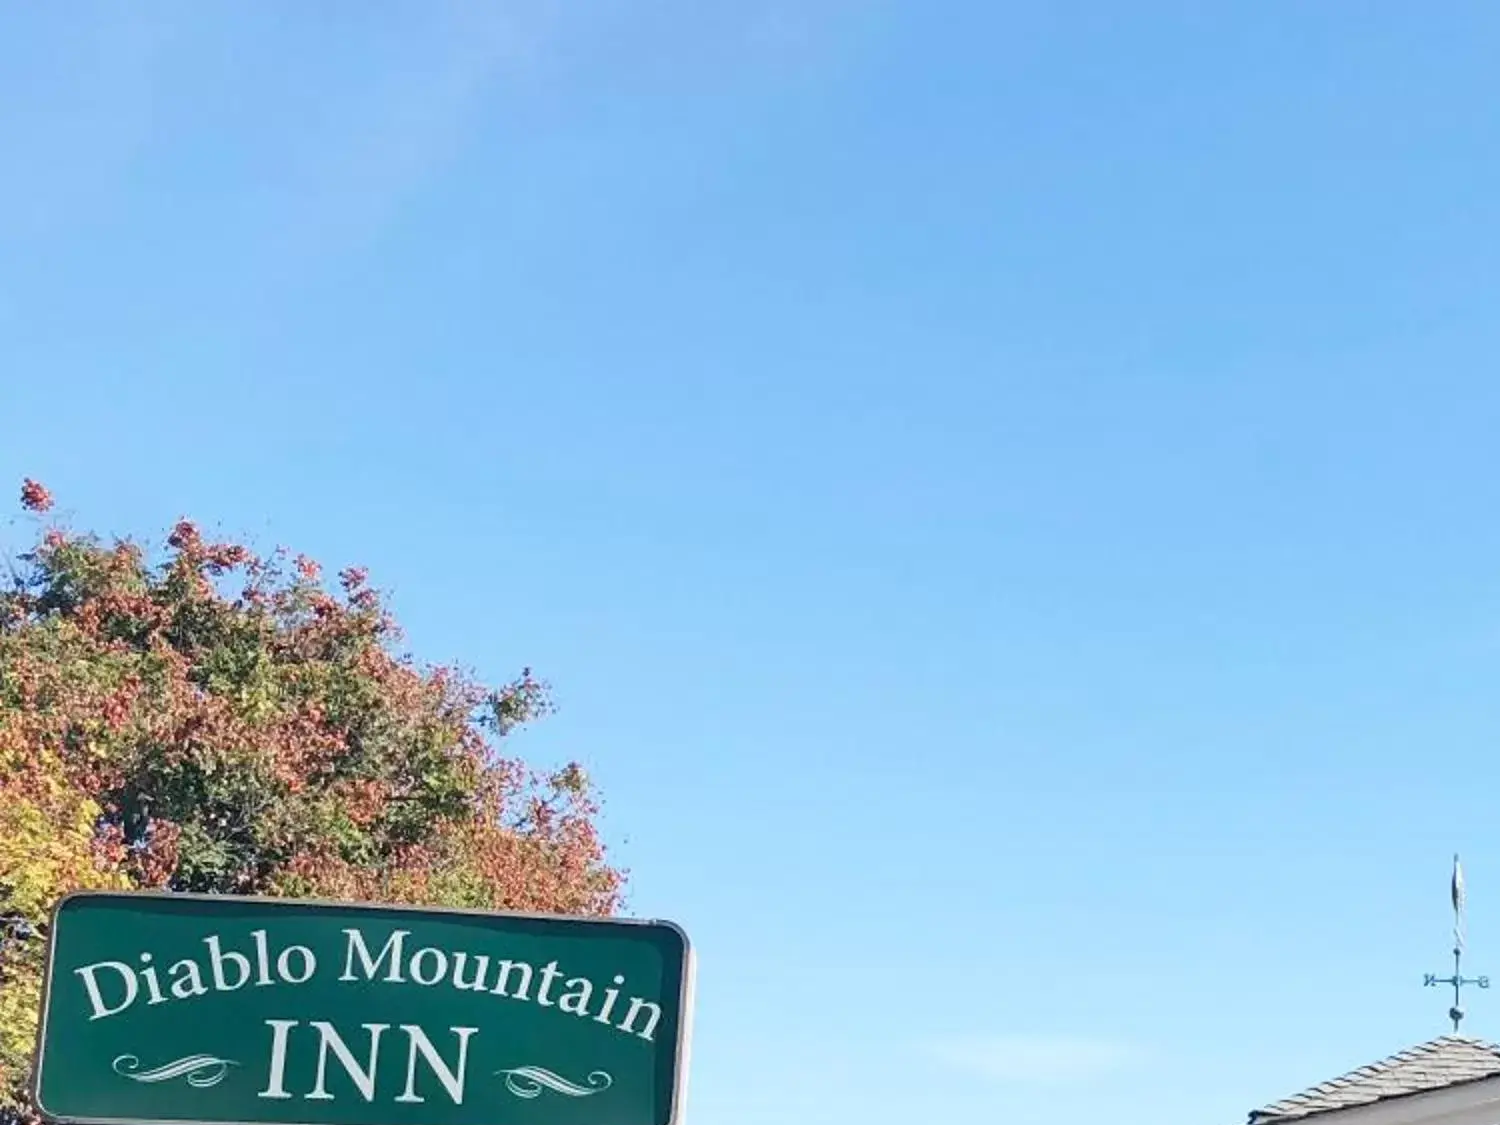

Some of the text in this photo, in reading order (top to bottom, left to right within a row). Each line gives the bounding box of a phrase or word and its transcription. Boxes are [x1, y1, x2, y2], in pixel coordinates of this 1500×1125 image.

[74, 929, 664, 1041] Diablo Mountain
[257, 1018, 479, 1105] INN
